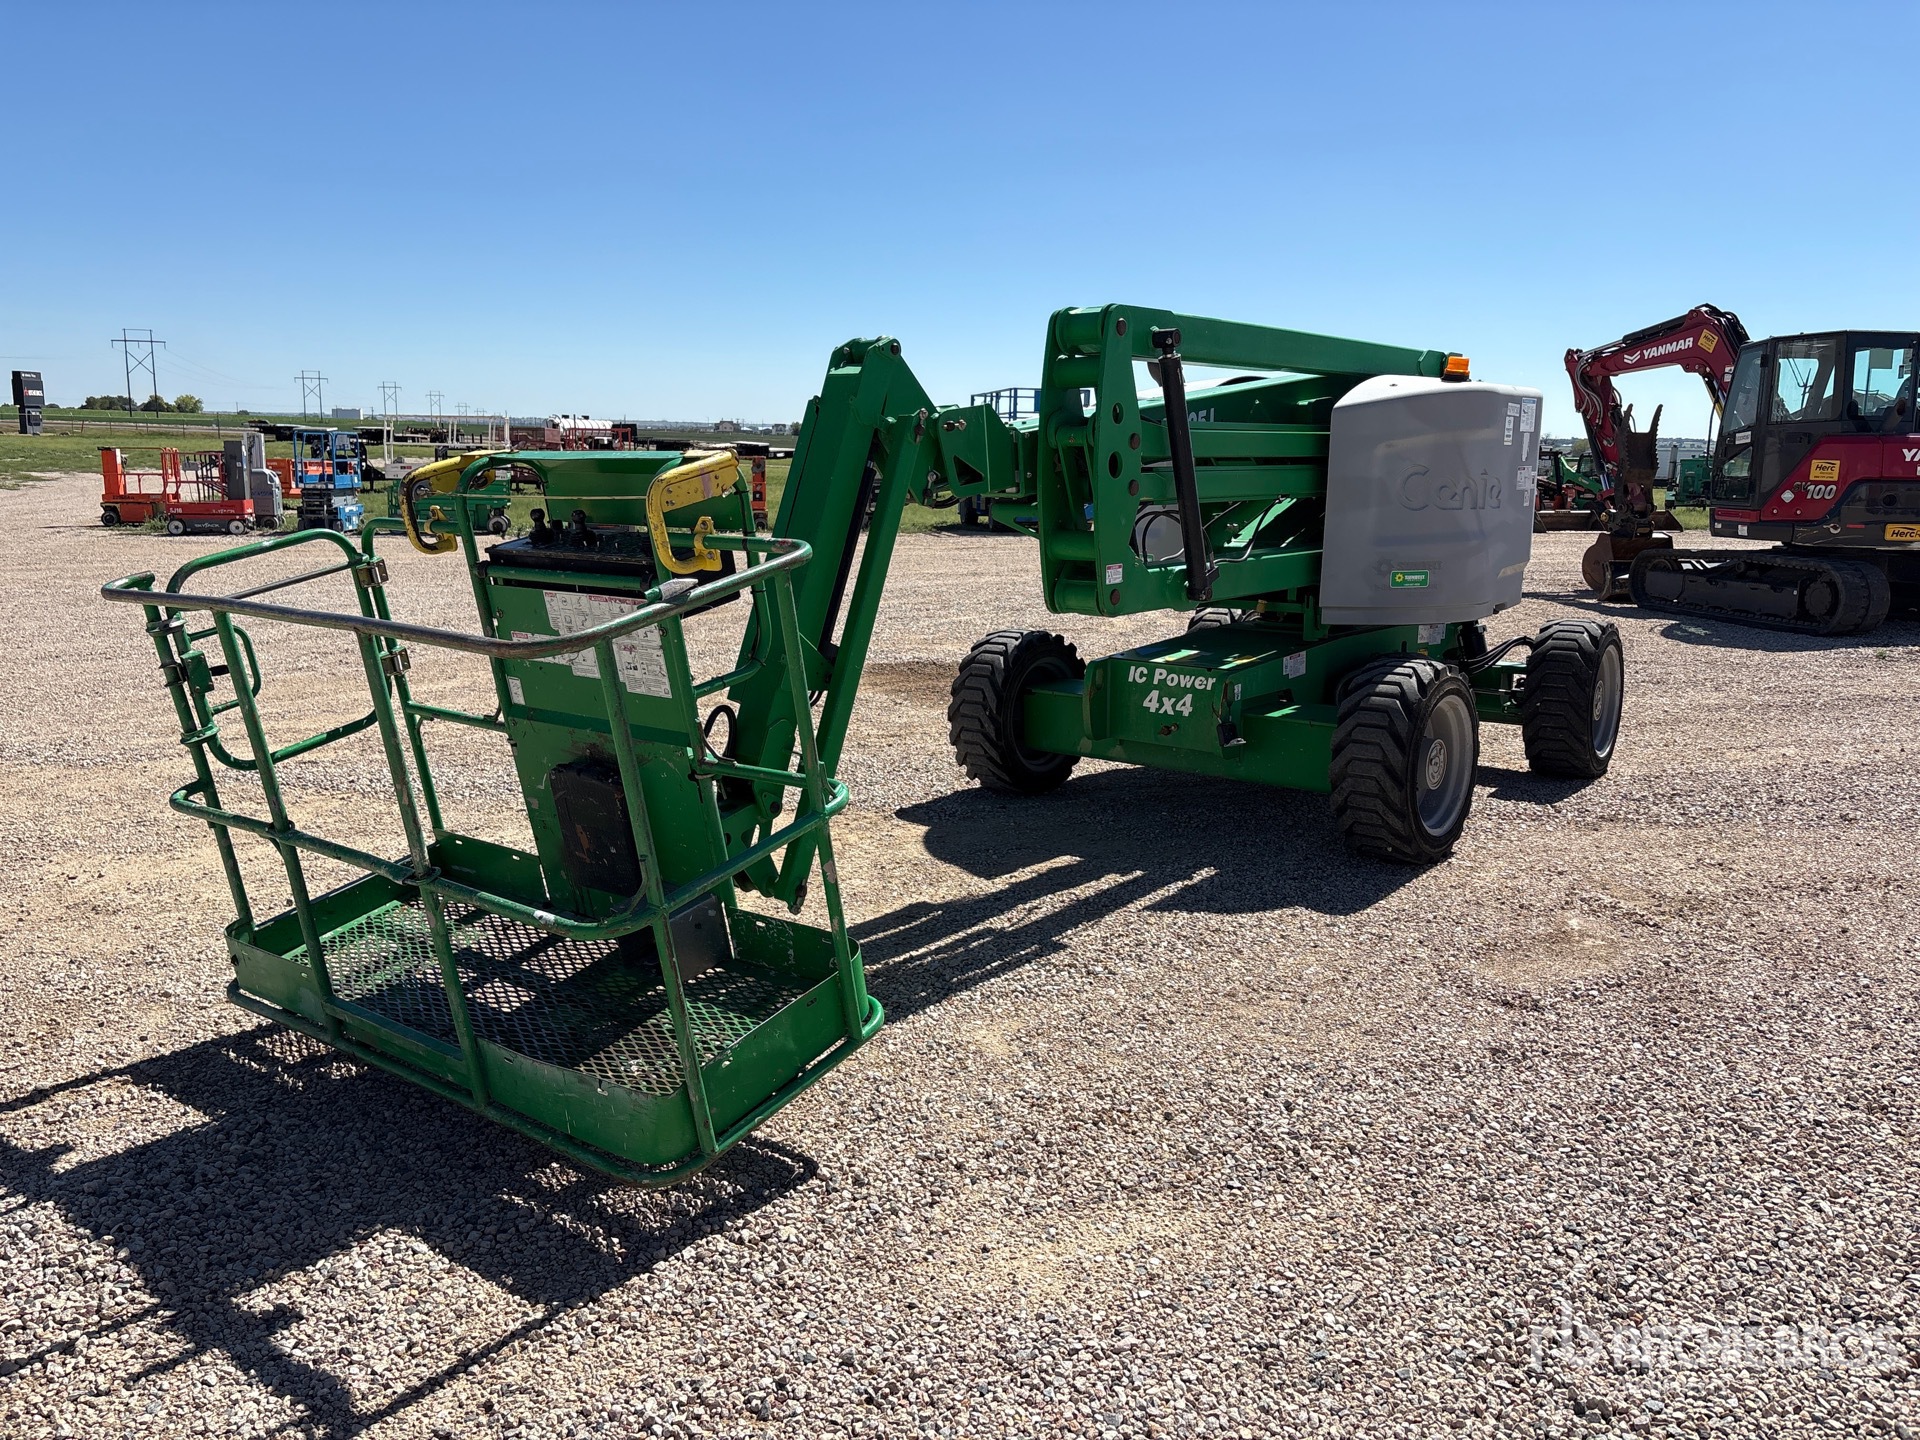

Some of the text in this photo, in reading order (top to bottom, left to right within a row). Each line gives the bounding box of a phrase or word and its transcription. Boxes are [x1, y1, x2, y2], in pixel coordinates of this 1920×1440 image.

[1643, 337, 1694, 360] YANMAR
[1815, 464, 1836, 472] Herc
[1127, 665, 1217, 691] IC Power
[1142, 689, 1194, 717] 4x4
